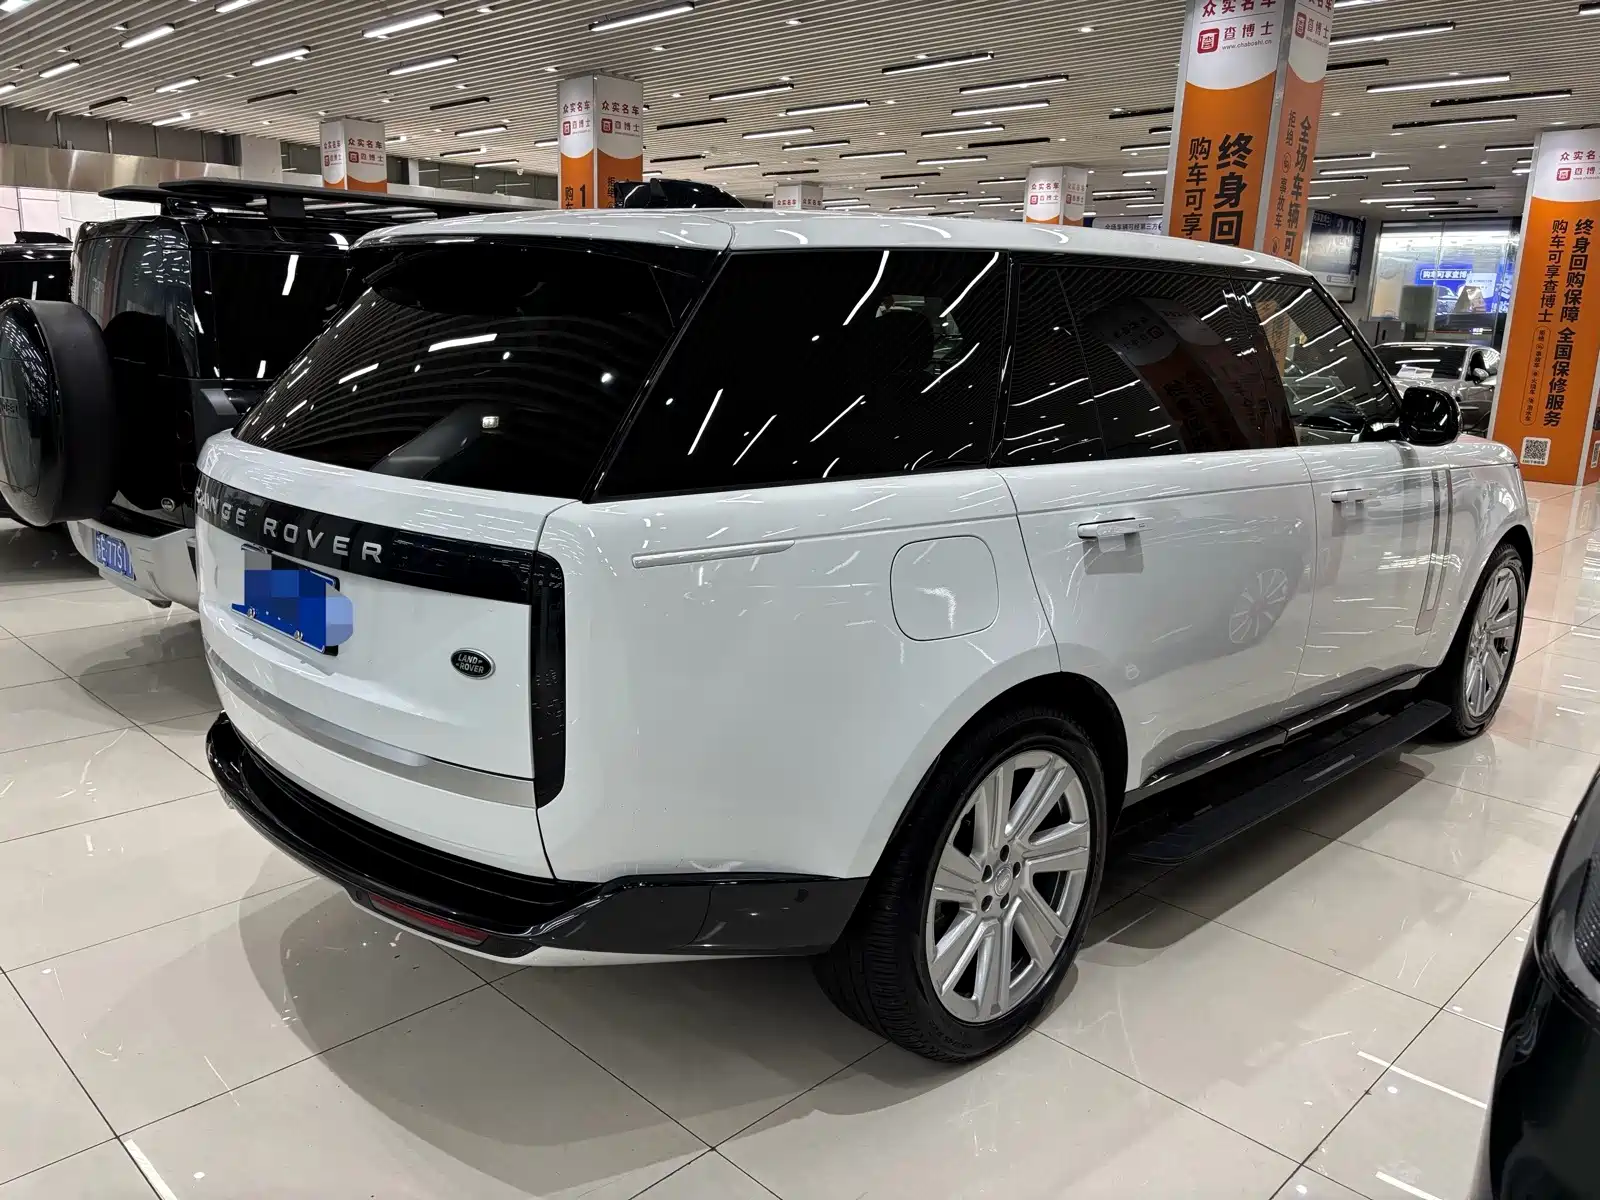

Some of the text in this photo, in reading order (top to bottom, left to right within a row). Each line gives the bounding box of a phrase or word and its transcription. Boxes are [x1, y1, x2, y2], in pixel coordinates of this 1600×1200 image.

[1222, 21, 1274, 41] 查博士
[1221, 39, 1273, 50] www.chaboshi.cn
[563, 100, 591, 114] 众实名车
[601, 100, 640, 116] 众实名车
[348, 137, 383, 150] 众实名车
[1559, 149, 1600, 162] 众实名
[1181, 136, 1212, 237] 购车可享
[1209, 132, 1254, 247] 终身回
[1283, 115, 1312, 259] 全场车辆可
[1537, 218, 1569, 323] 购车可享查博士
[1559, 218, 1595, 323] 终身回购保障
[1543, 326, 1577, 428] 全国保修服务
[263, 517, 383, 564] ROVER
[458, 653, 479, 665] LAND
[459, 662, 485, 674] ROVER
